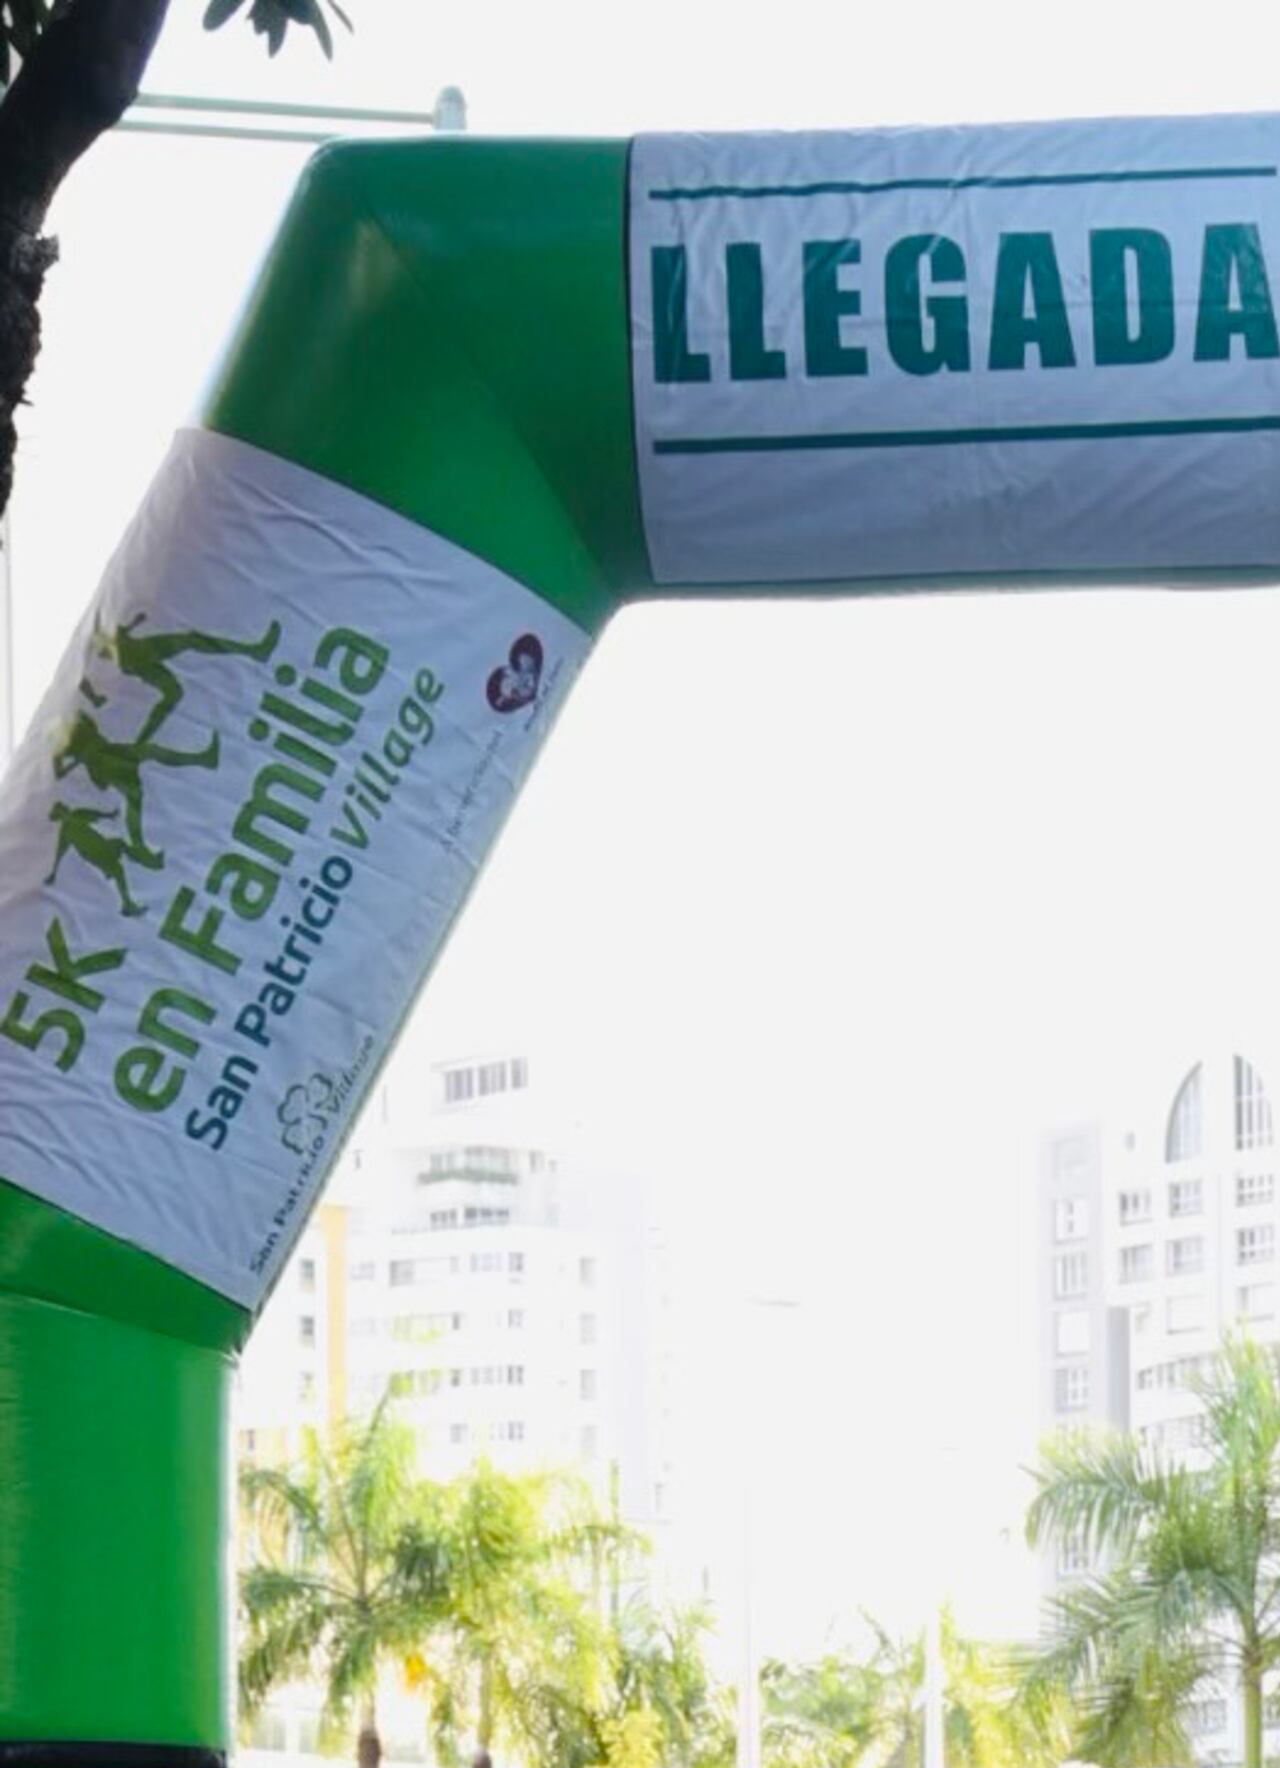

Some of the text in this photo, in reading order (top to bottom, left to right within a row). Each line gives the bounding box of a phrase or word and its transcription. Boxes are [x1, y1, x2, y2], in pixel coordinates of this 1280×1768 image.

[0, 916, 131, 1075] 5K
[113, 626, 391, 1114] en Familia
[184, 666, 446, 1152] San Patricio Village
